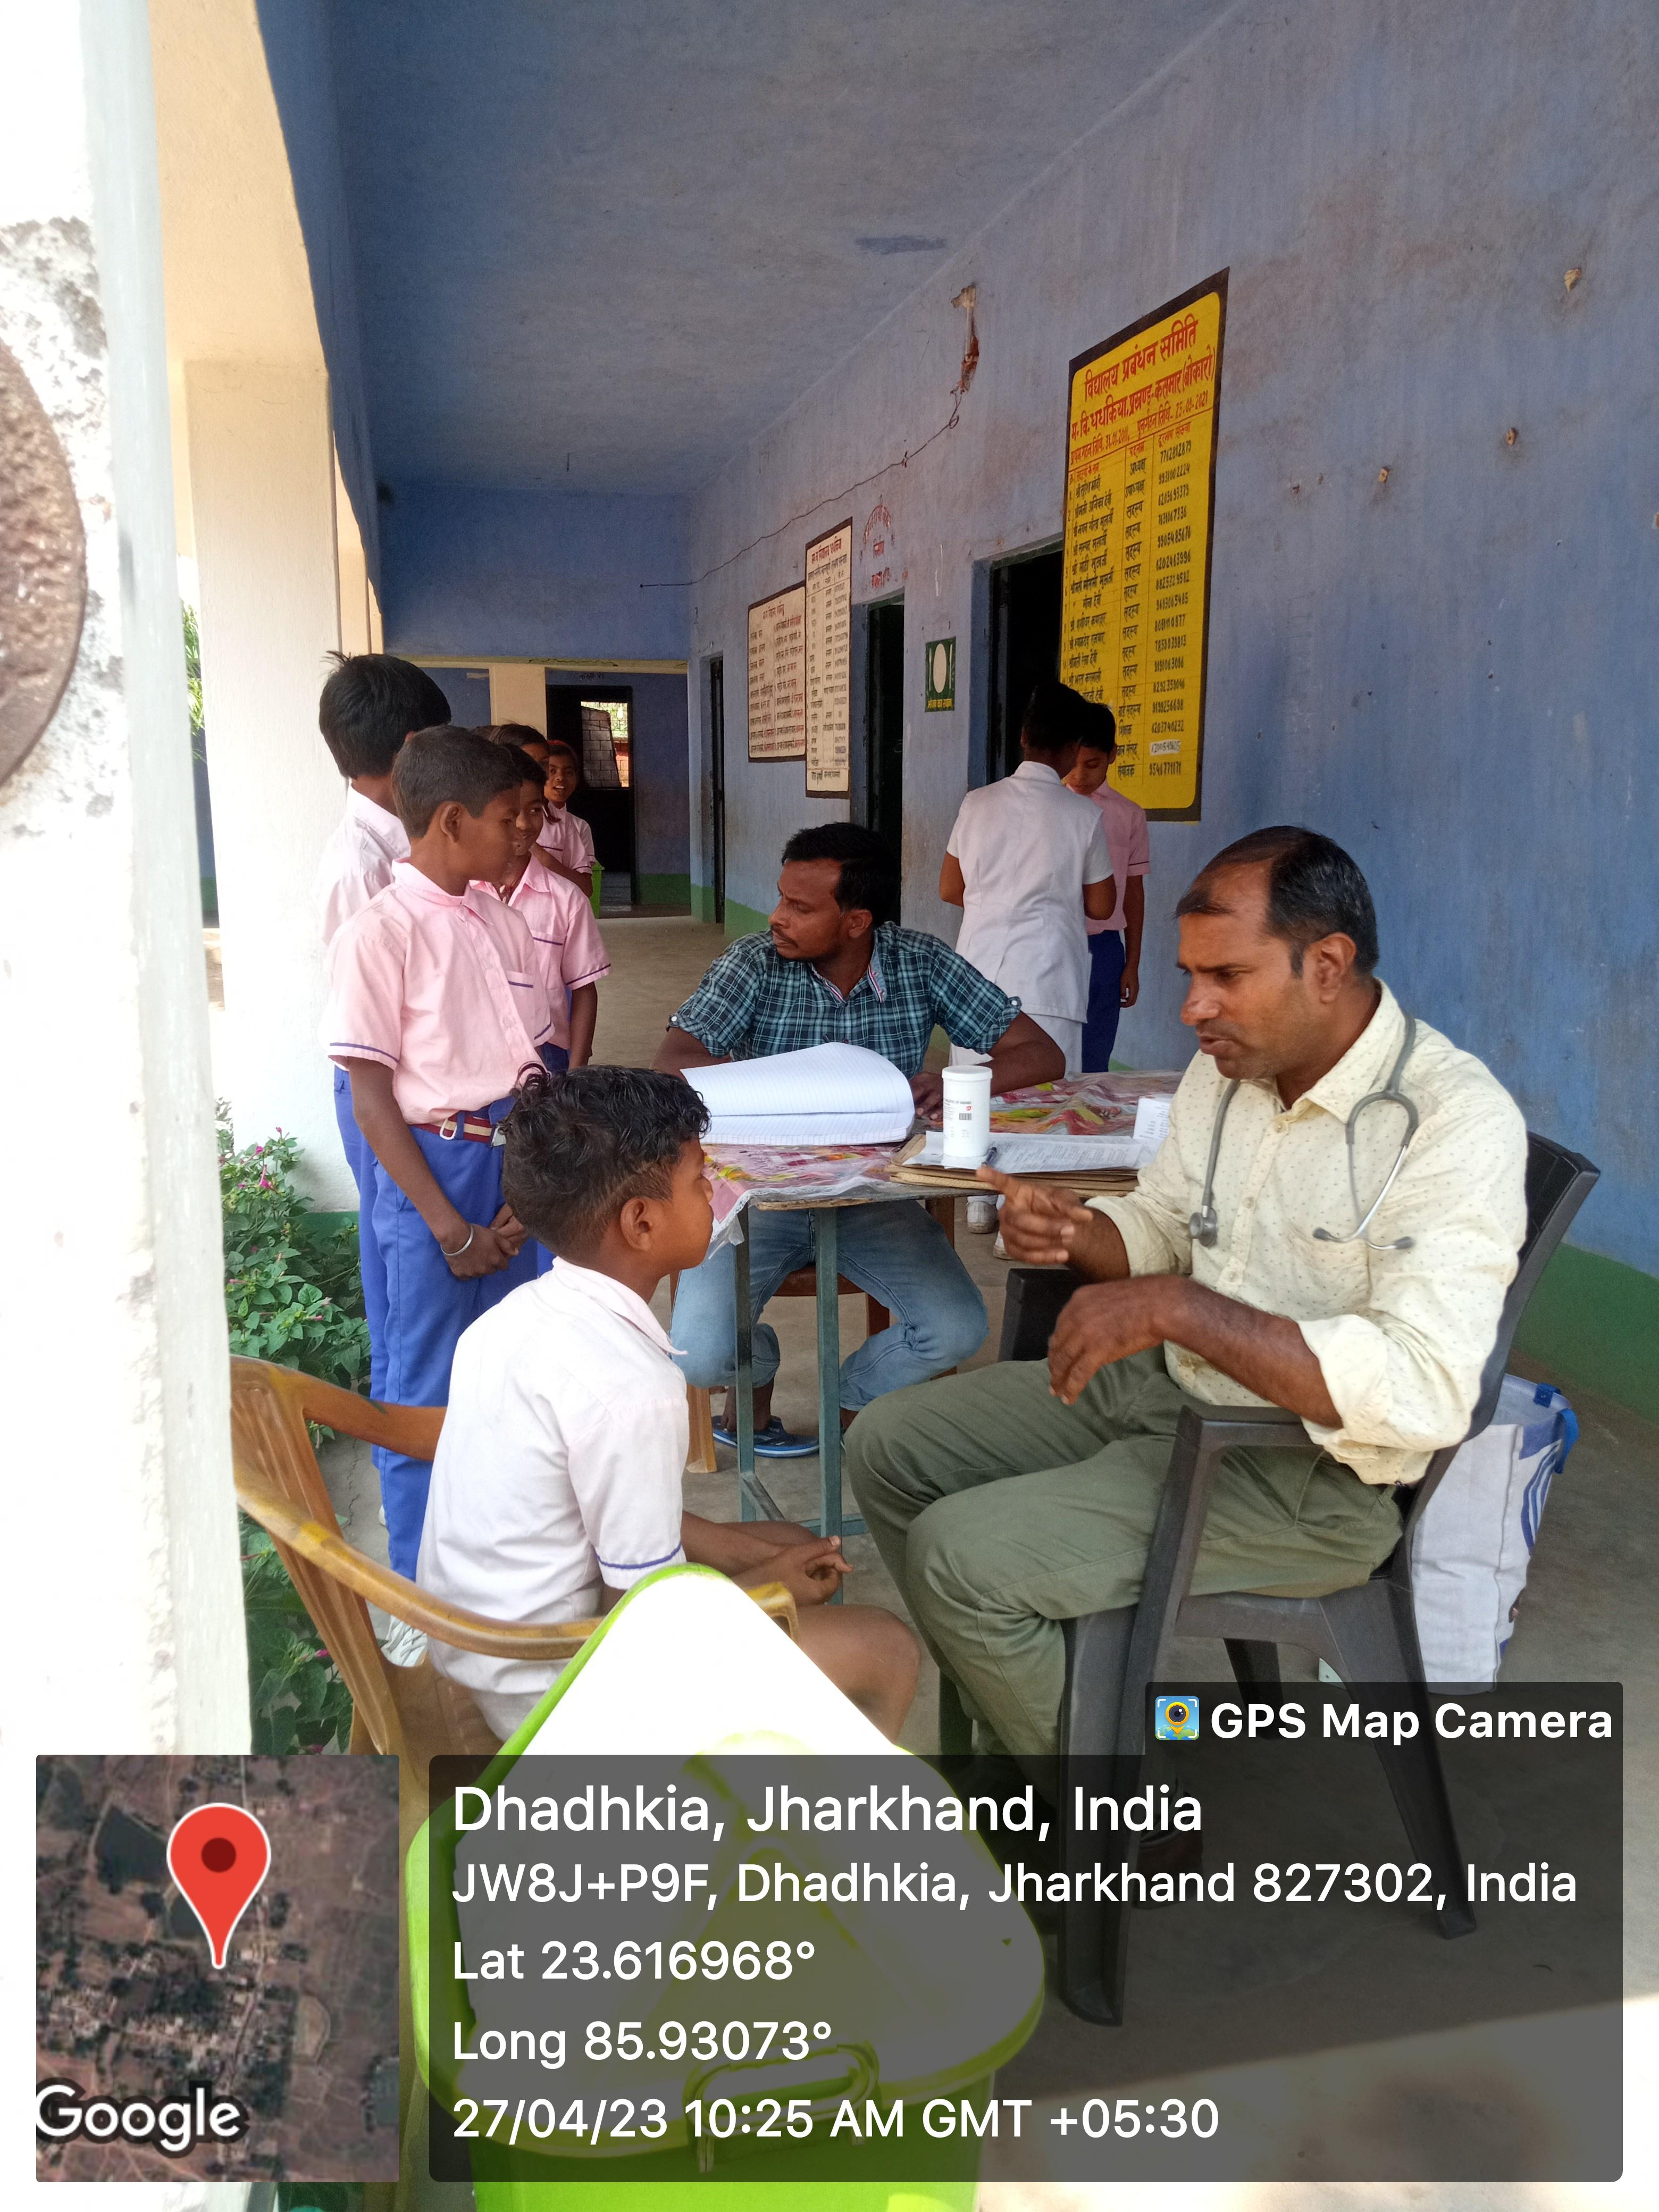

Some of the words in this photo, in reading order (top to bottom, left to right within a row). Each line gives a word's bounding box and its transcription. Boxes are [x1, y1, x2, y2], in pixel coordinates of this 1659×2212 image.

[1084, 363, 1120, 401] विद्यालय
[1122, 341, 1158, 382] प्रबंधन
[1160, 314, 1199, 361] समिति
